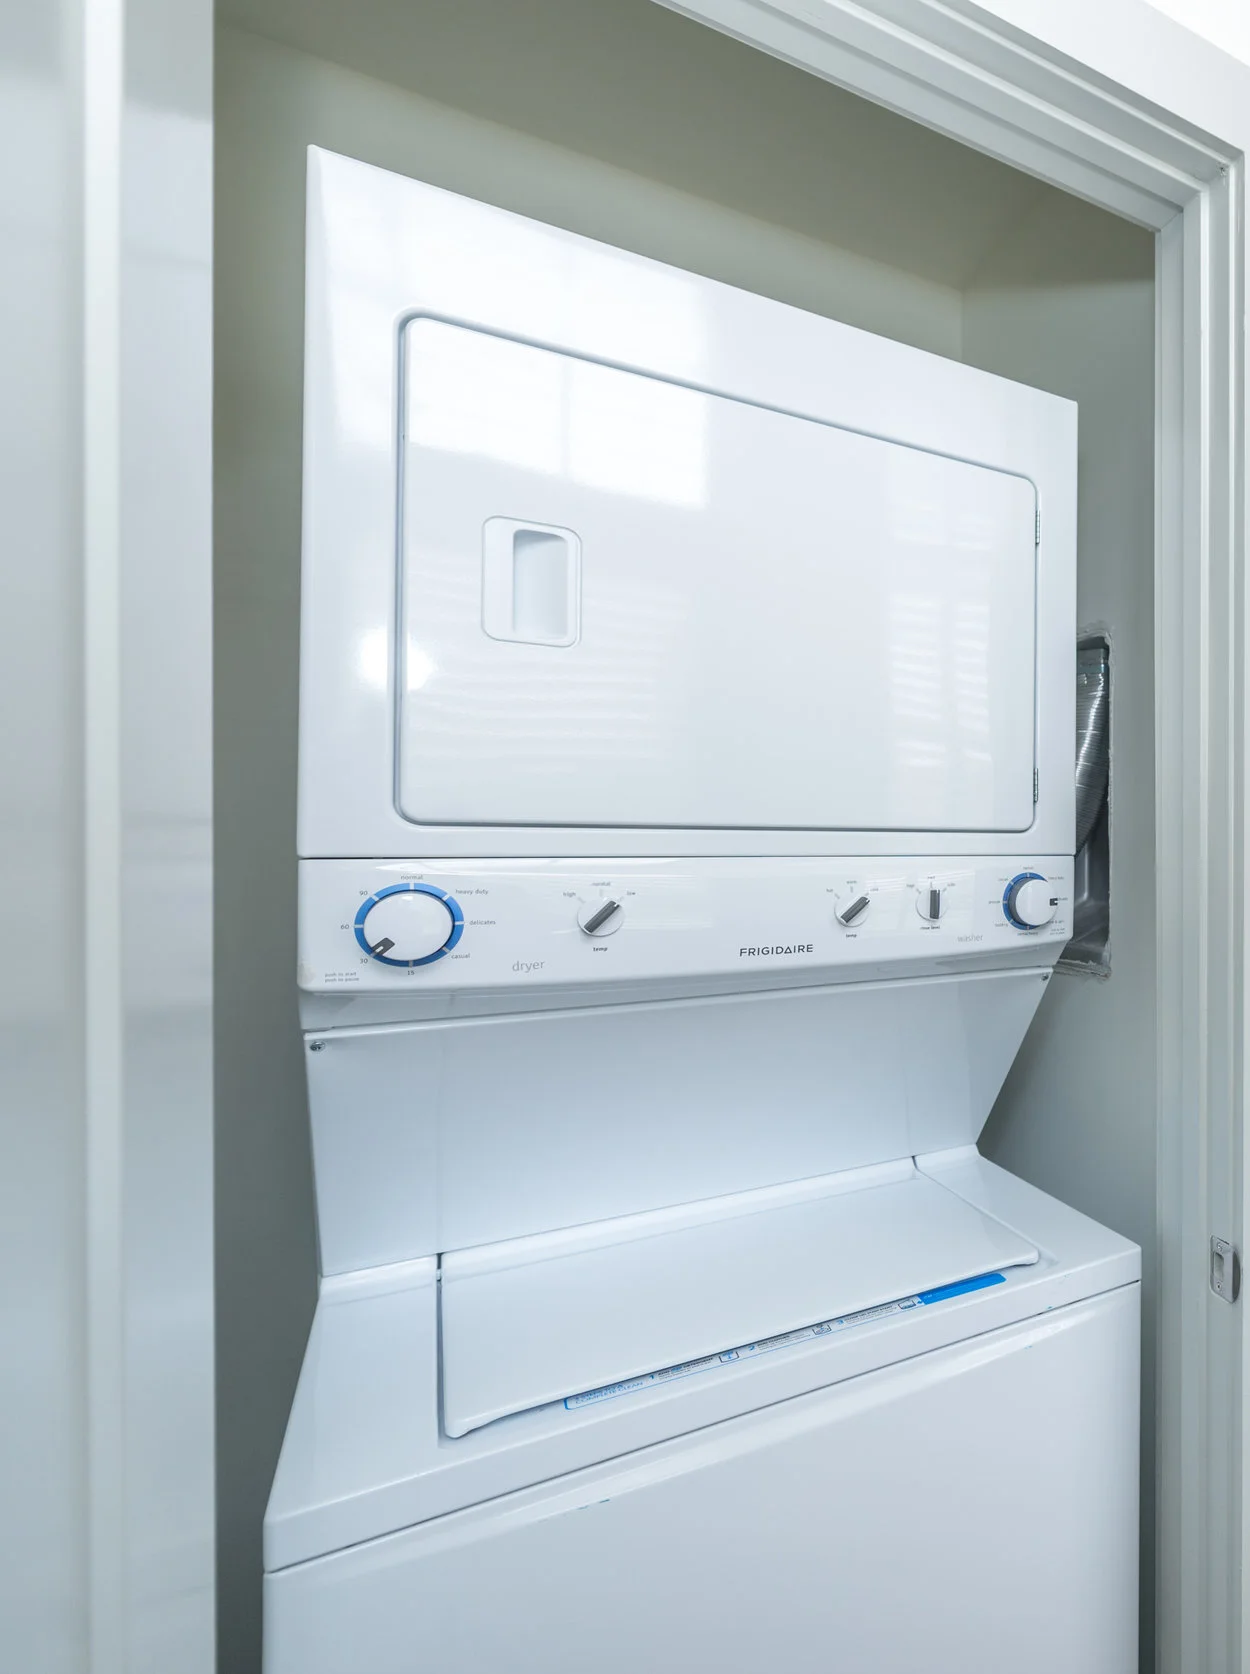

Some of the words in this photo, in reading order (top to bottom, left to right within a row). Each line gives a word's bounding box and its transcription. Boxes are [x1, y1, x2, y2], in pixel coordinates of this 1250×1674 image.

[563, 890, 576, 898] high
[957, 934, 983, 942] washer
[739, 944, 814, 957] FRIGIDAIRE
[451, 952, 471, 960] casual
[512, 959, 545, 973] dryer
